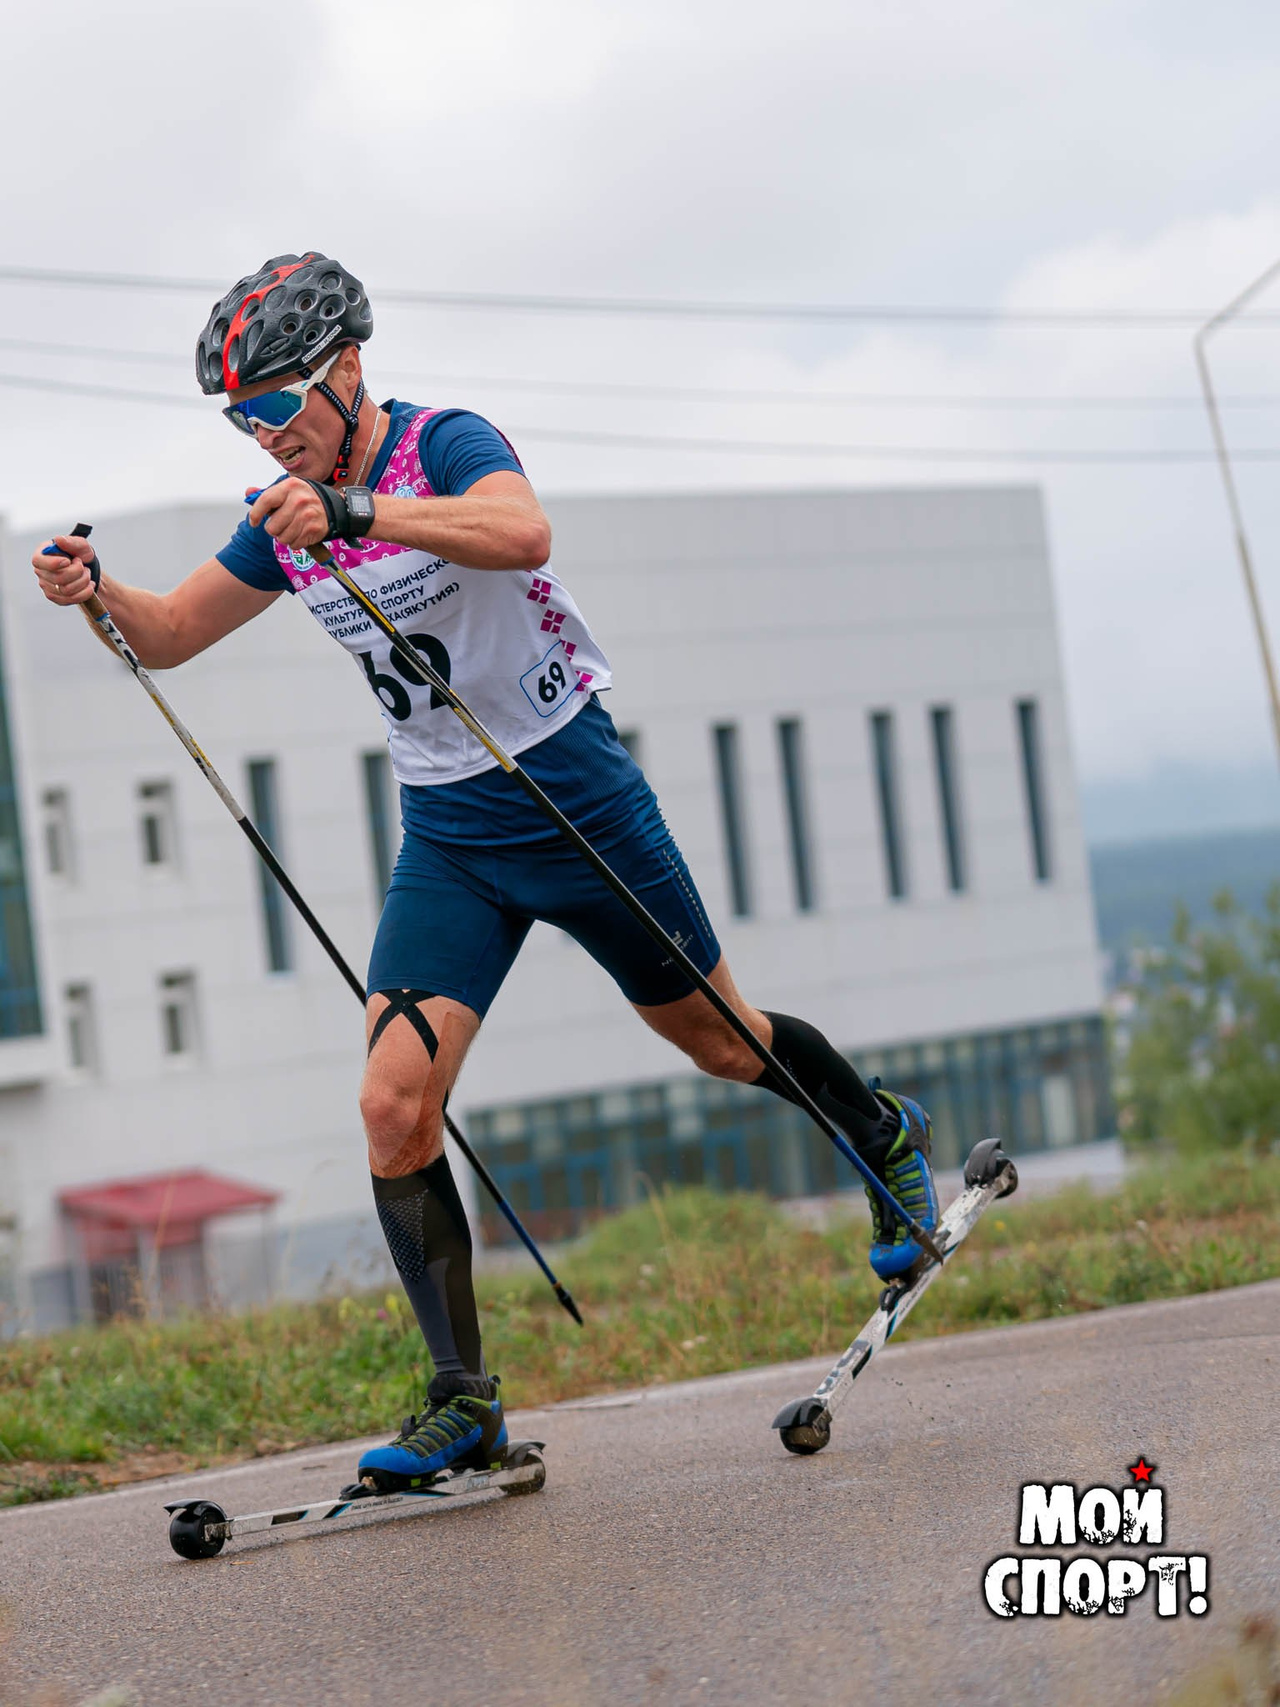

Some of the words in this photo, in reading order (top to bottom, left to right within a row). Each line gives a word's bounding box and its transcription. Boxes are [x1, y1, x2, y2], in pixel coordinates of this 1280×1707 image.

[308, 597, 356, 615] ИСТЕРСТВ
[380, 559, 450, 595] ФИЗИЧЕСК
[323, 608, 366, 627] КУЛЬТУР
[381, 585, 424, 610] СПОРТУ
[328, 620, 372, 639] УБЛИКИ
[386, 582, 460, 622] ХА(ЯКУТИЯ)
[358, 633, 451, 721] 69
[538, 661, 566, 703] 69
